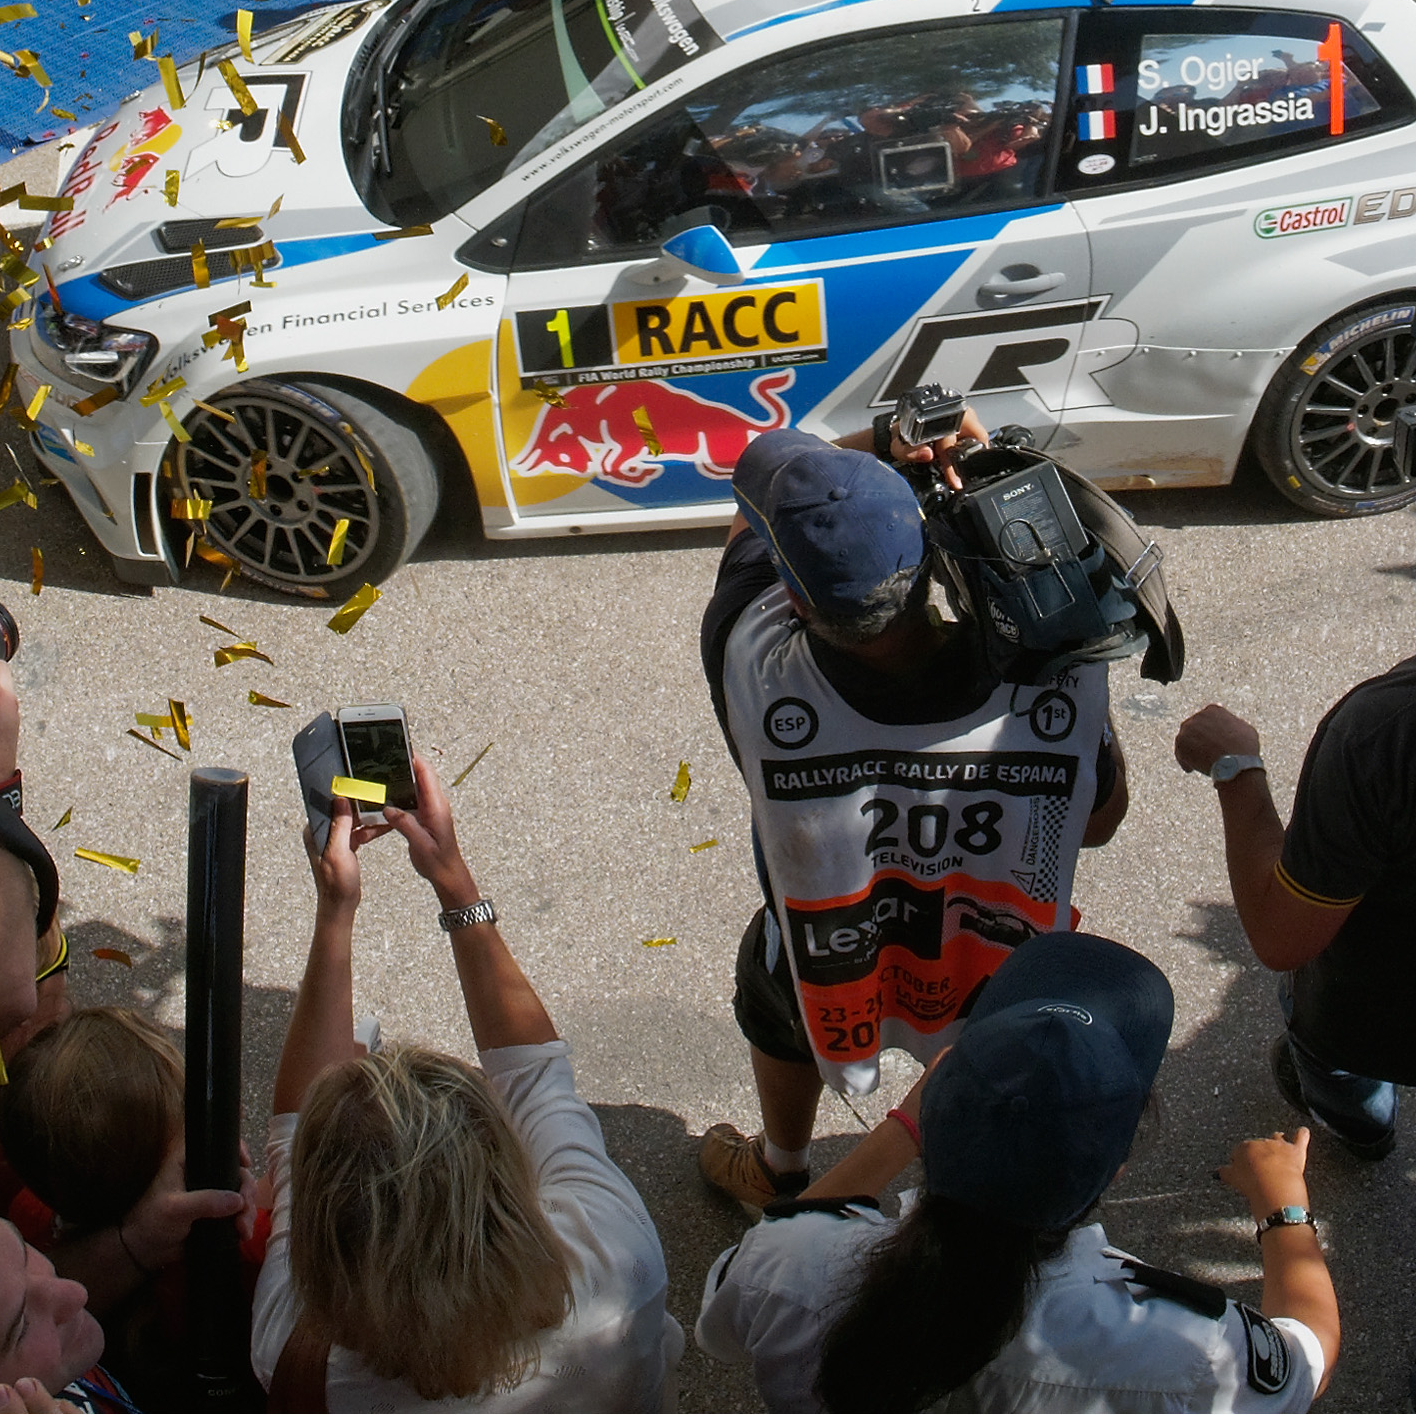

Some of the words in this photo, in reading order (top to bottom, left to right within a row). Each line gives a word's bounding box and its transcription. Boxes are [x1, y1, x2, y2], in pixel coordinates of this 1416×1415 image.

[1136, 59, 1170, 91] S.
[1179, 54, 1265, 87] Ogier
[1316, 22, 1345, 136] 1
[520, 76, 685, 183] www.volkswagen-motorsport.com
[1138, 104, 1168, 136] J.
[1178, 92, 1315, 138] Ingrassia
[1278, 202, 1346, 234] Castrol
[281, 302, 388, 331] Financial
[545, 309, 576, 369] 1
[635, 290, 800, 358] RACC
[1327, 307, 1412, 354] MICHELIN
[578, 371, 600, 384] FIA
[601, 368, 637, 382] World
[638, 364, 670, 381] Rally
[670, 357, 756, 376] Championship
[1002, 482, 1032, 502] SONY
[775, 716, 806, 732] ESP
[1042, 704, 1066, 731] 1st
[773, 760, 887, 790] RALLYRACC
[894, 762, 959, 780] RALLY
[964, 763, 990, 781] DE
[996, 764, 1067, 784] ESPANA
[859, 798, 1004, 858] 208
[1026, 796, 1040, 866] DANGEROUS
[870, 851, 964, 876] TELEVISION
[879, 965, 951, 995] CTOBER
[818, 1007, 847, 1023] 23
